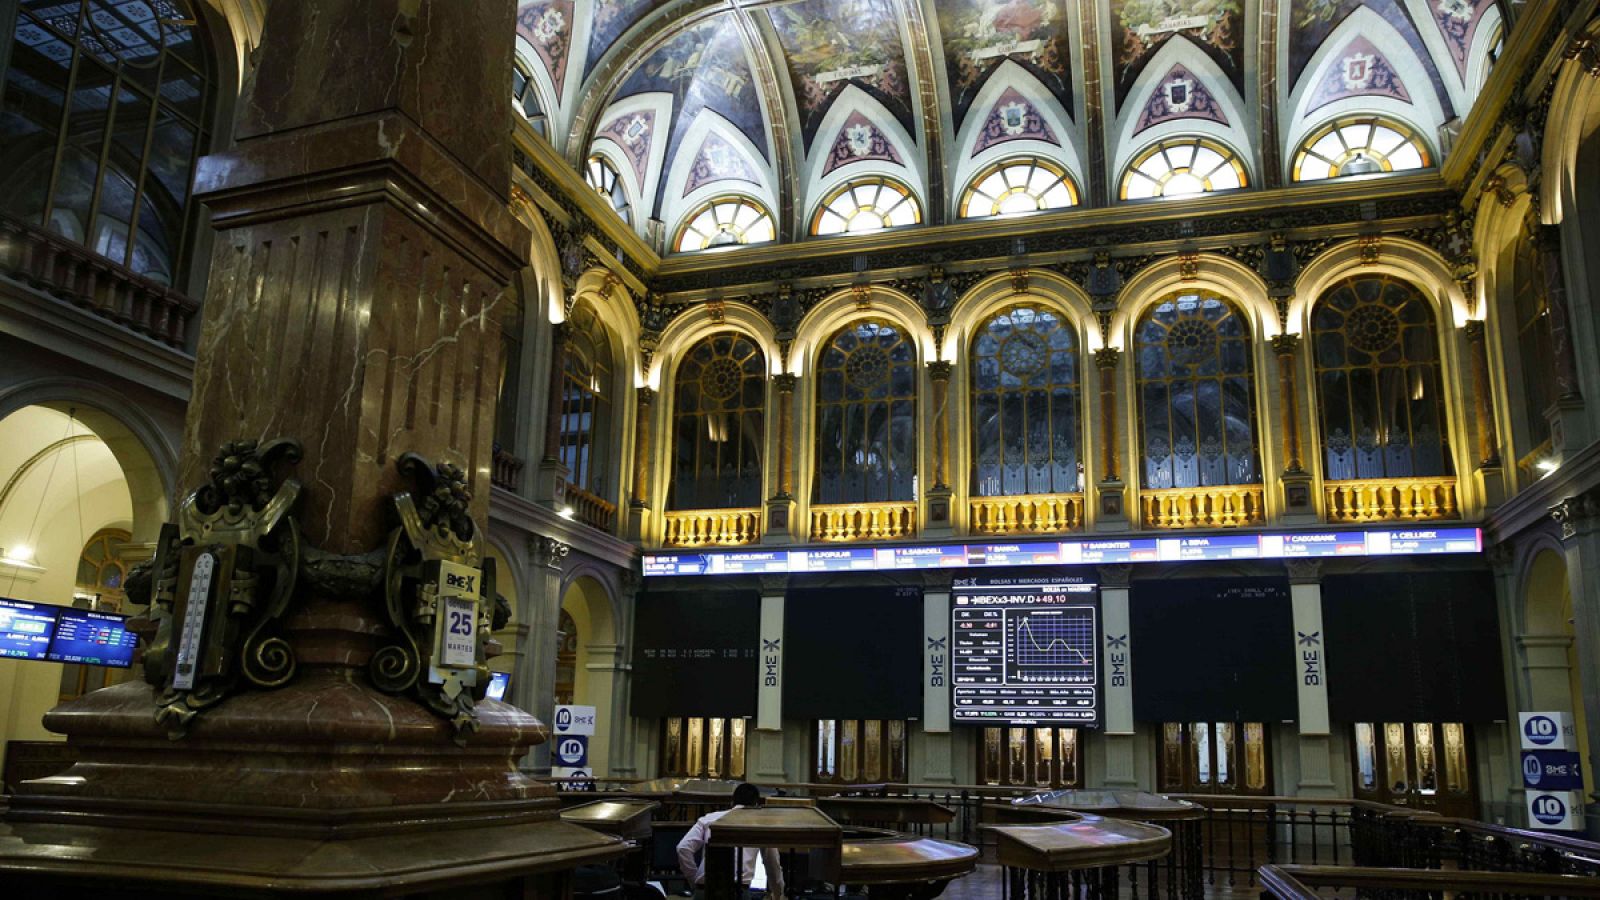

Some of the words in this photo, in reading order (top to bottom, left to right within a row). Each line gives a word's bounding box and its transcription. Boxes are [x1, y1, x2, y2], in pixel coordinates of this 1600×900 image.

[450, 612, 472, 636] 25
[448, 643, 472, 652] MARTES
[765, 655, 777, 686] BME
[931, 654, 943, 687] BME
[1111, 653, 1125, 687] BME
[1303, 650, 1319, 685] BME
[560, 711, 569, 724] 10
[1530, 719, 1553, 736] 10
[565, 743, 580, 754] 10
[1526, 760, 1538, 774] 10
[1544, 764, 1568, 775] BME
[1538, 798, 1561, 815] 10
